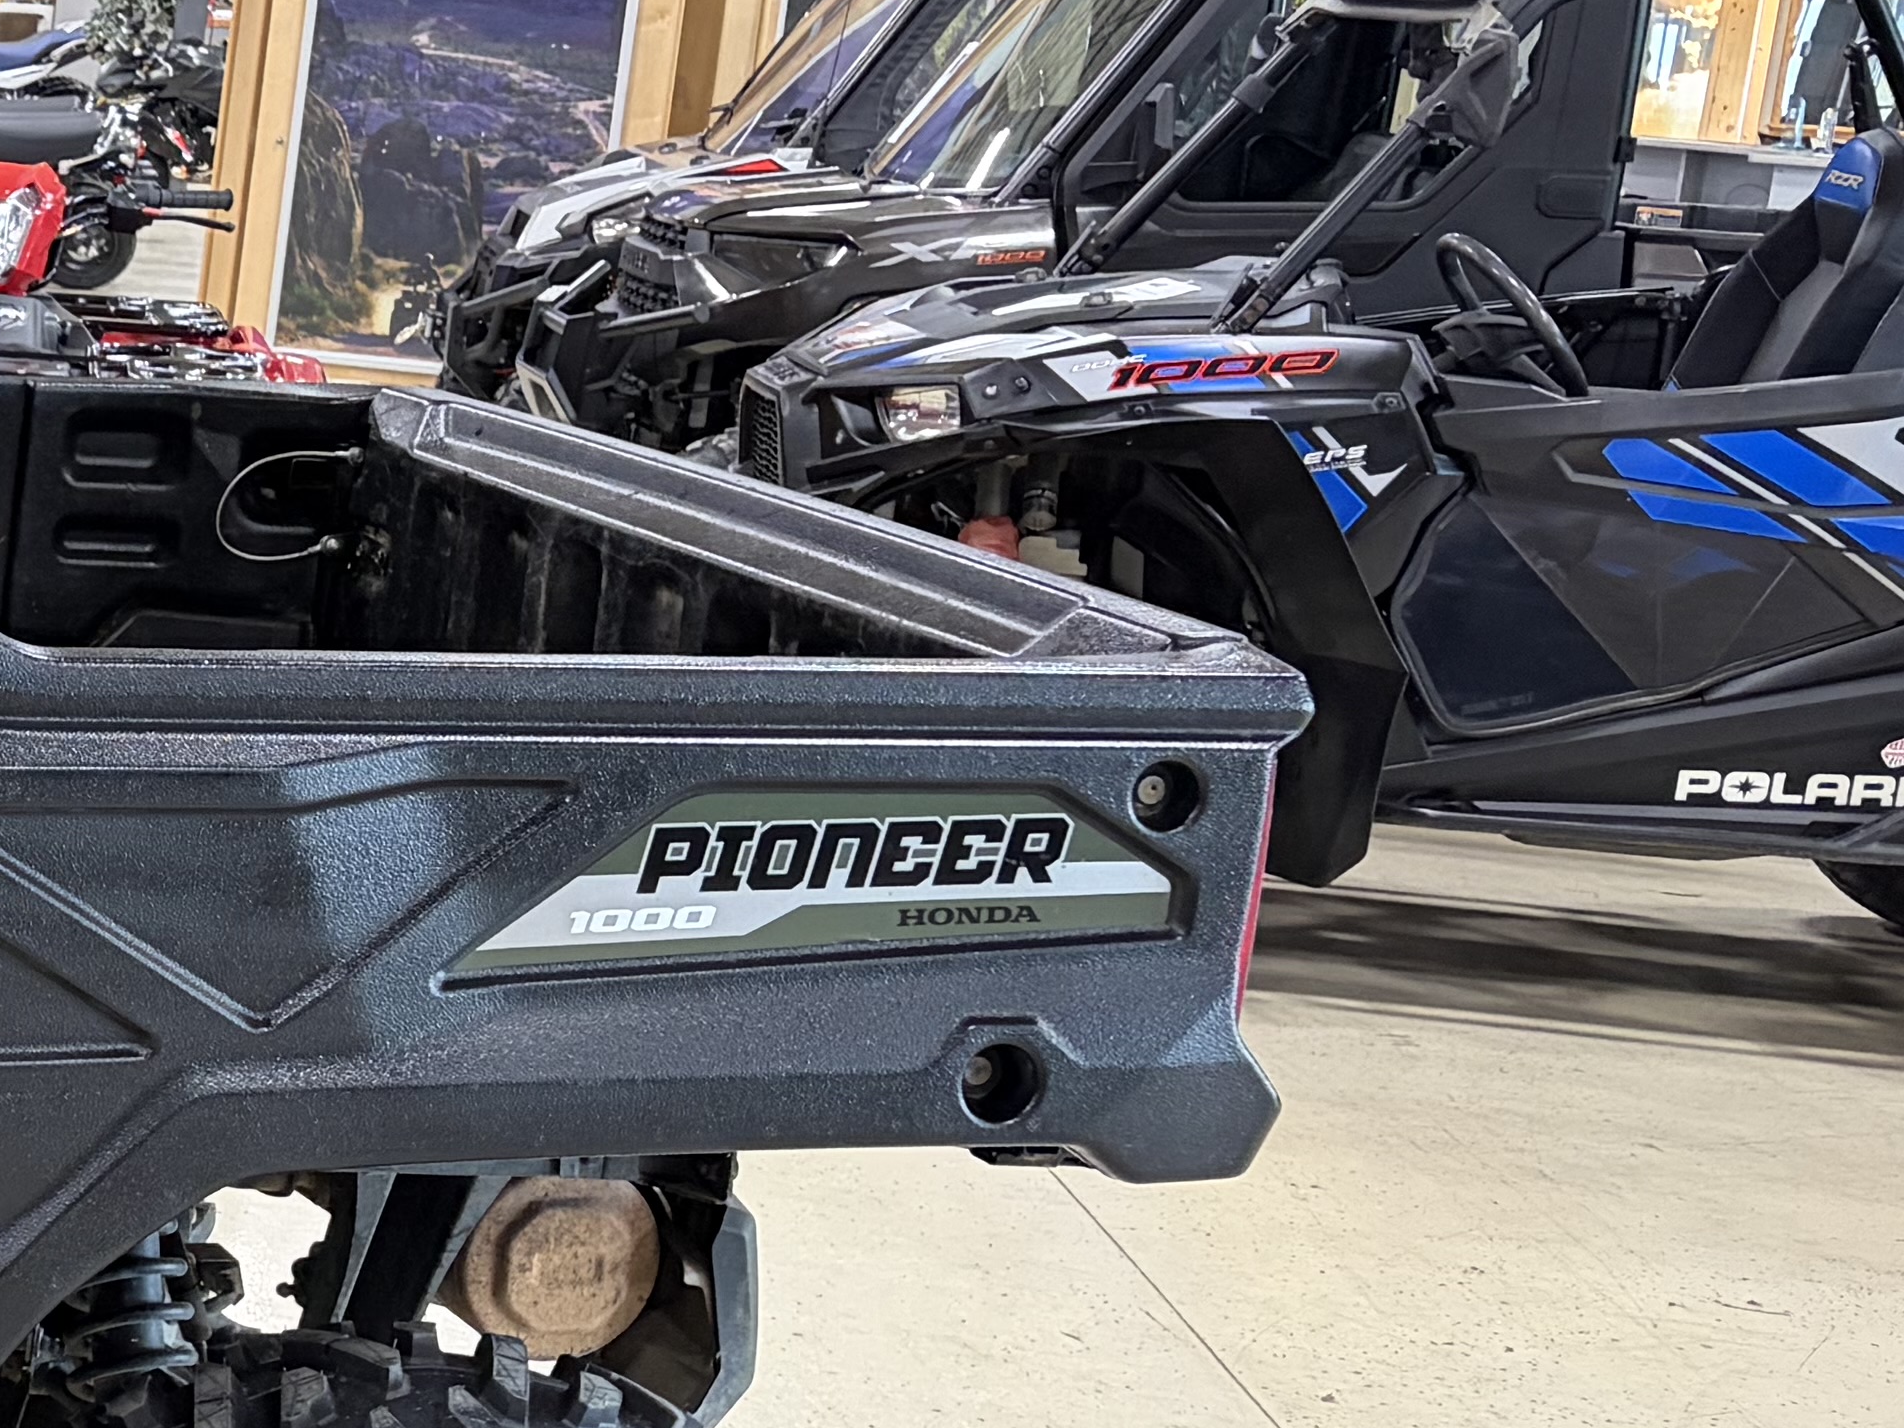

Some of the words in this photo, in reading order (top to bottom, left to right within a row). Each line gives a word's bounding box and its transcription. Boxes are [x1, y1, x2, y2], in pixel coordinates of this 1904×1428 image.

[1824, 169, 1864, 190] RZR
[976, 250, 1046, 266] 1000
[1107, 348, 1341, 392] 1000
[1303, 444, 1368, 465] EPS
[635, 813, 1076, 896] PIONEER
[568, 904, 717, 935] 1000
[896, 905, 1042, 928] HONDA
